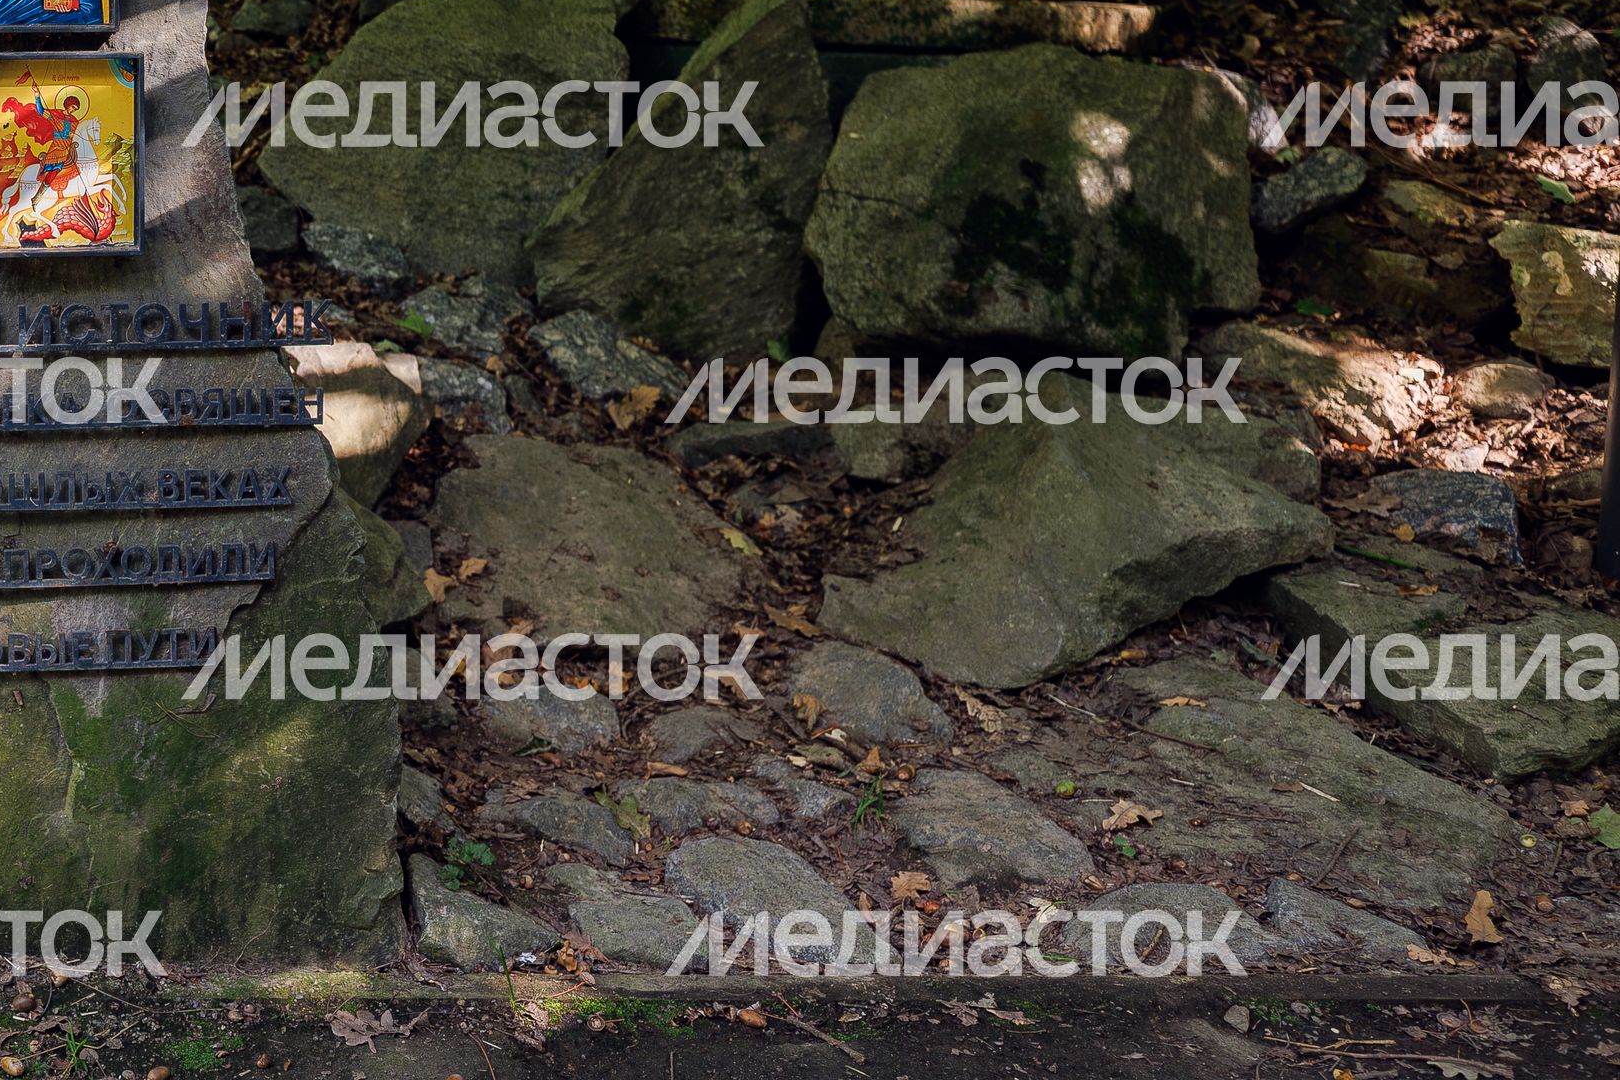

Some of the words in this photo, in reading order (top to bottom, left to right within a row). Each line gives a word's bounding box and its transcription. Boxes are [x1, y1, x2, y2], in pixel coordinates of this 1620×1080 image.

[18, 299, 332, 350] ИСТОЧНИК
[157, 468, 292, 505] ВЕКАХ
[4, 542, 277, 585] ПРОХОДИЛИ
[106, 626, 217, 666] ПУТИ
